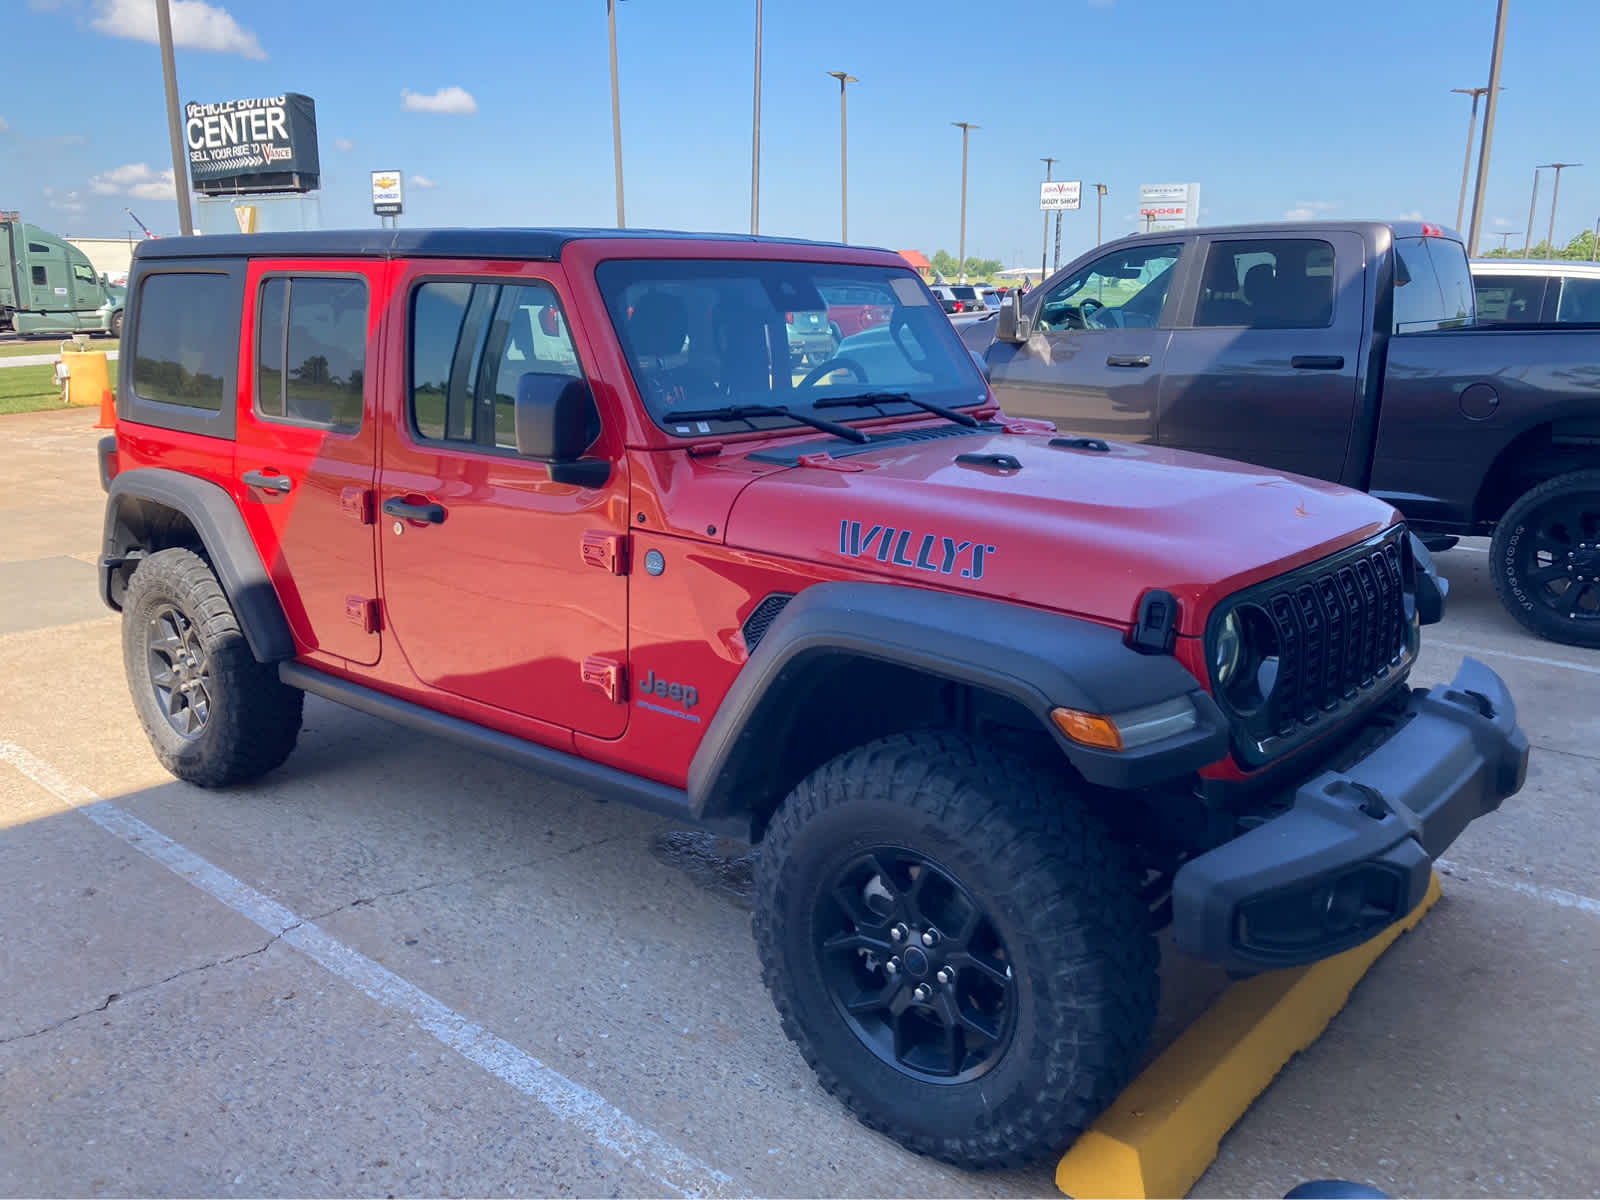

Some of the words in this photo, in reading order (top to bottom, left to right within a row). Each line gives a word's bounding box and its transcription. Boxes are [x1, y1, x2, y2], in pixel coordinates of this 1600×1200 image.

[187, 101, 235, 118] VEHICLE
[186, 106, 289, 150] CENTER
[190, 150, 210, 162] SELL
[209, 146, 232, 160] YOUR
[232, 144, 250, 157] RIDE
[250, 143, 260, 155] TO
[261, 143, 292, 165] VANCE
[1060, 197, 1078, 205] SHOP
[1141, 208, 1184, 216] DODGE
[839, 519, 997, 580] WILLYS
[639, 670, 699, 709] Jeep
